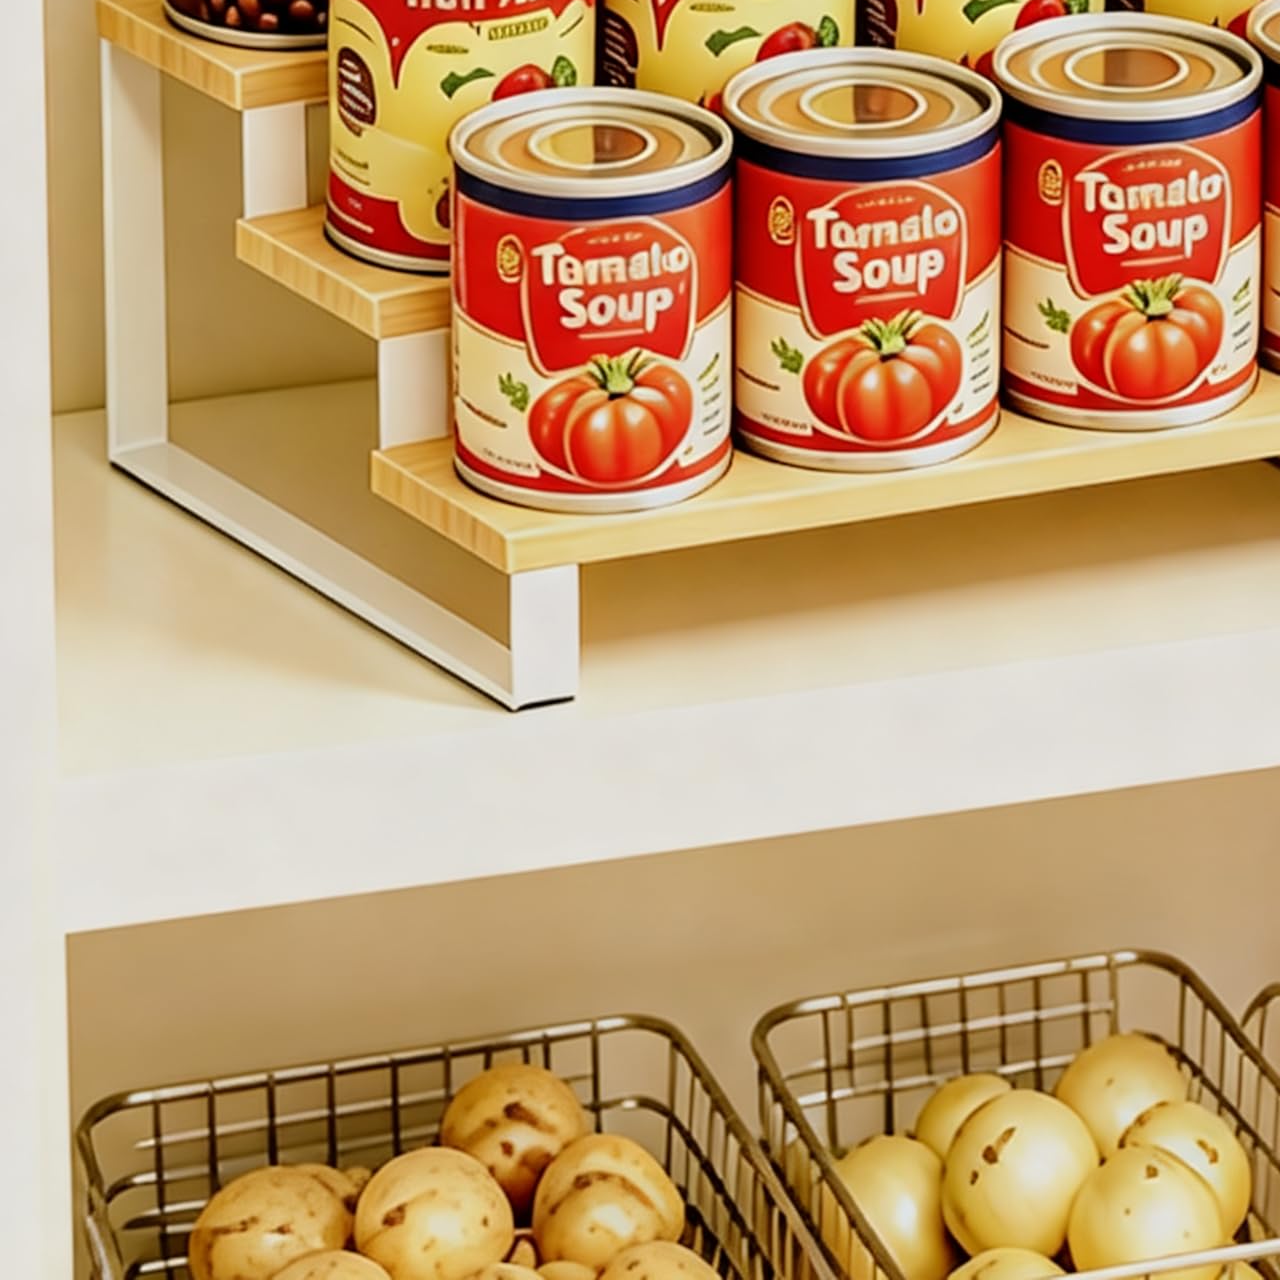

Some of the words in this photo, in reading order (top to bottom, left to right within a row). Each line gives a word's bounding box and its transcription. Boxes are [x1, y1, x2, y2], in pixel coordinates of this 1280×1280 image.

[1101, 212, 1209, 258] Soup
[832, 246, 946, 296] Soup
[558, 286, 675, 334] Soup
